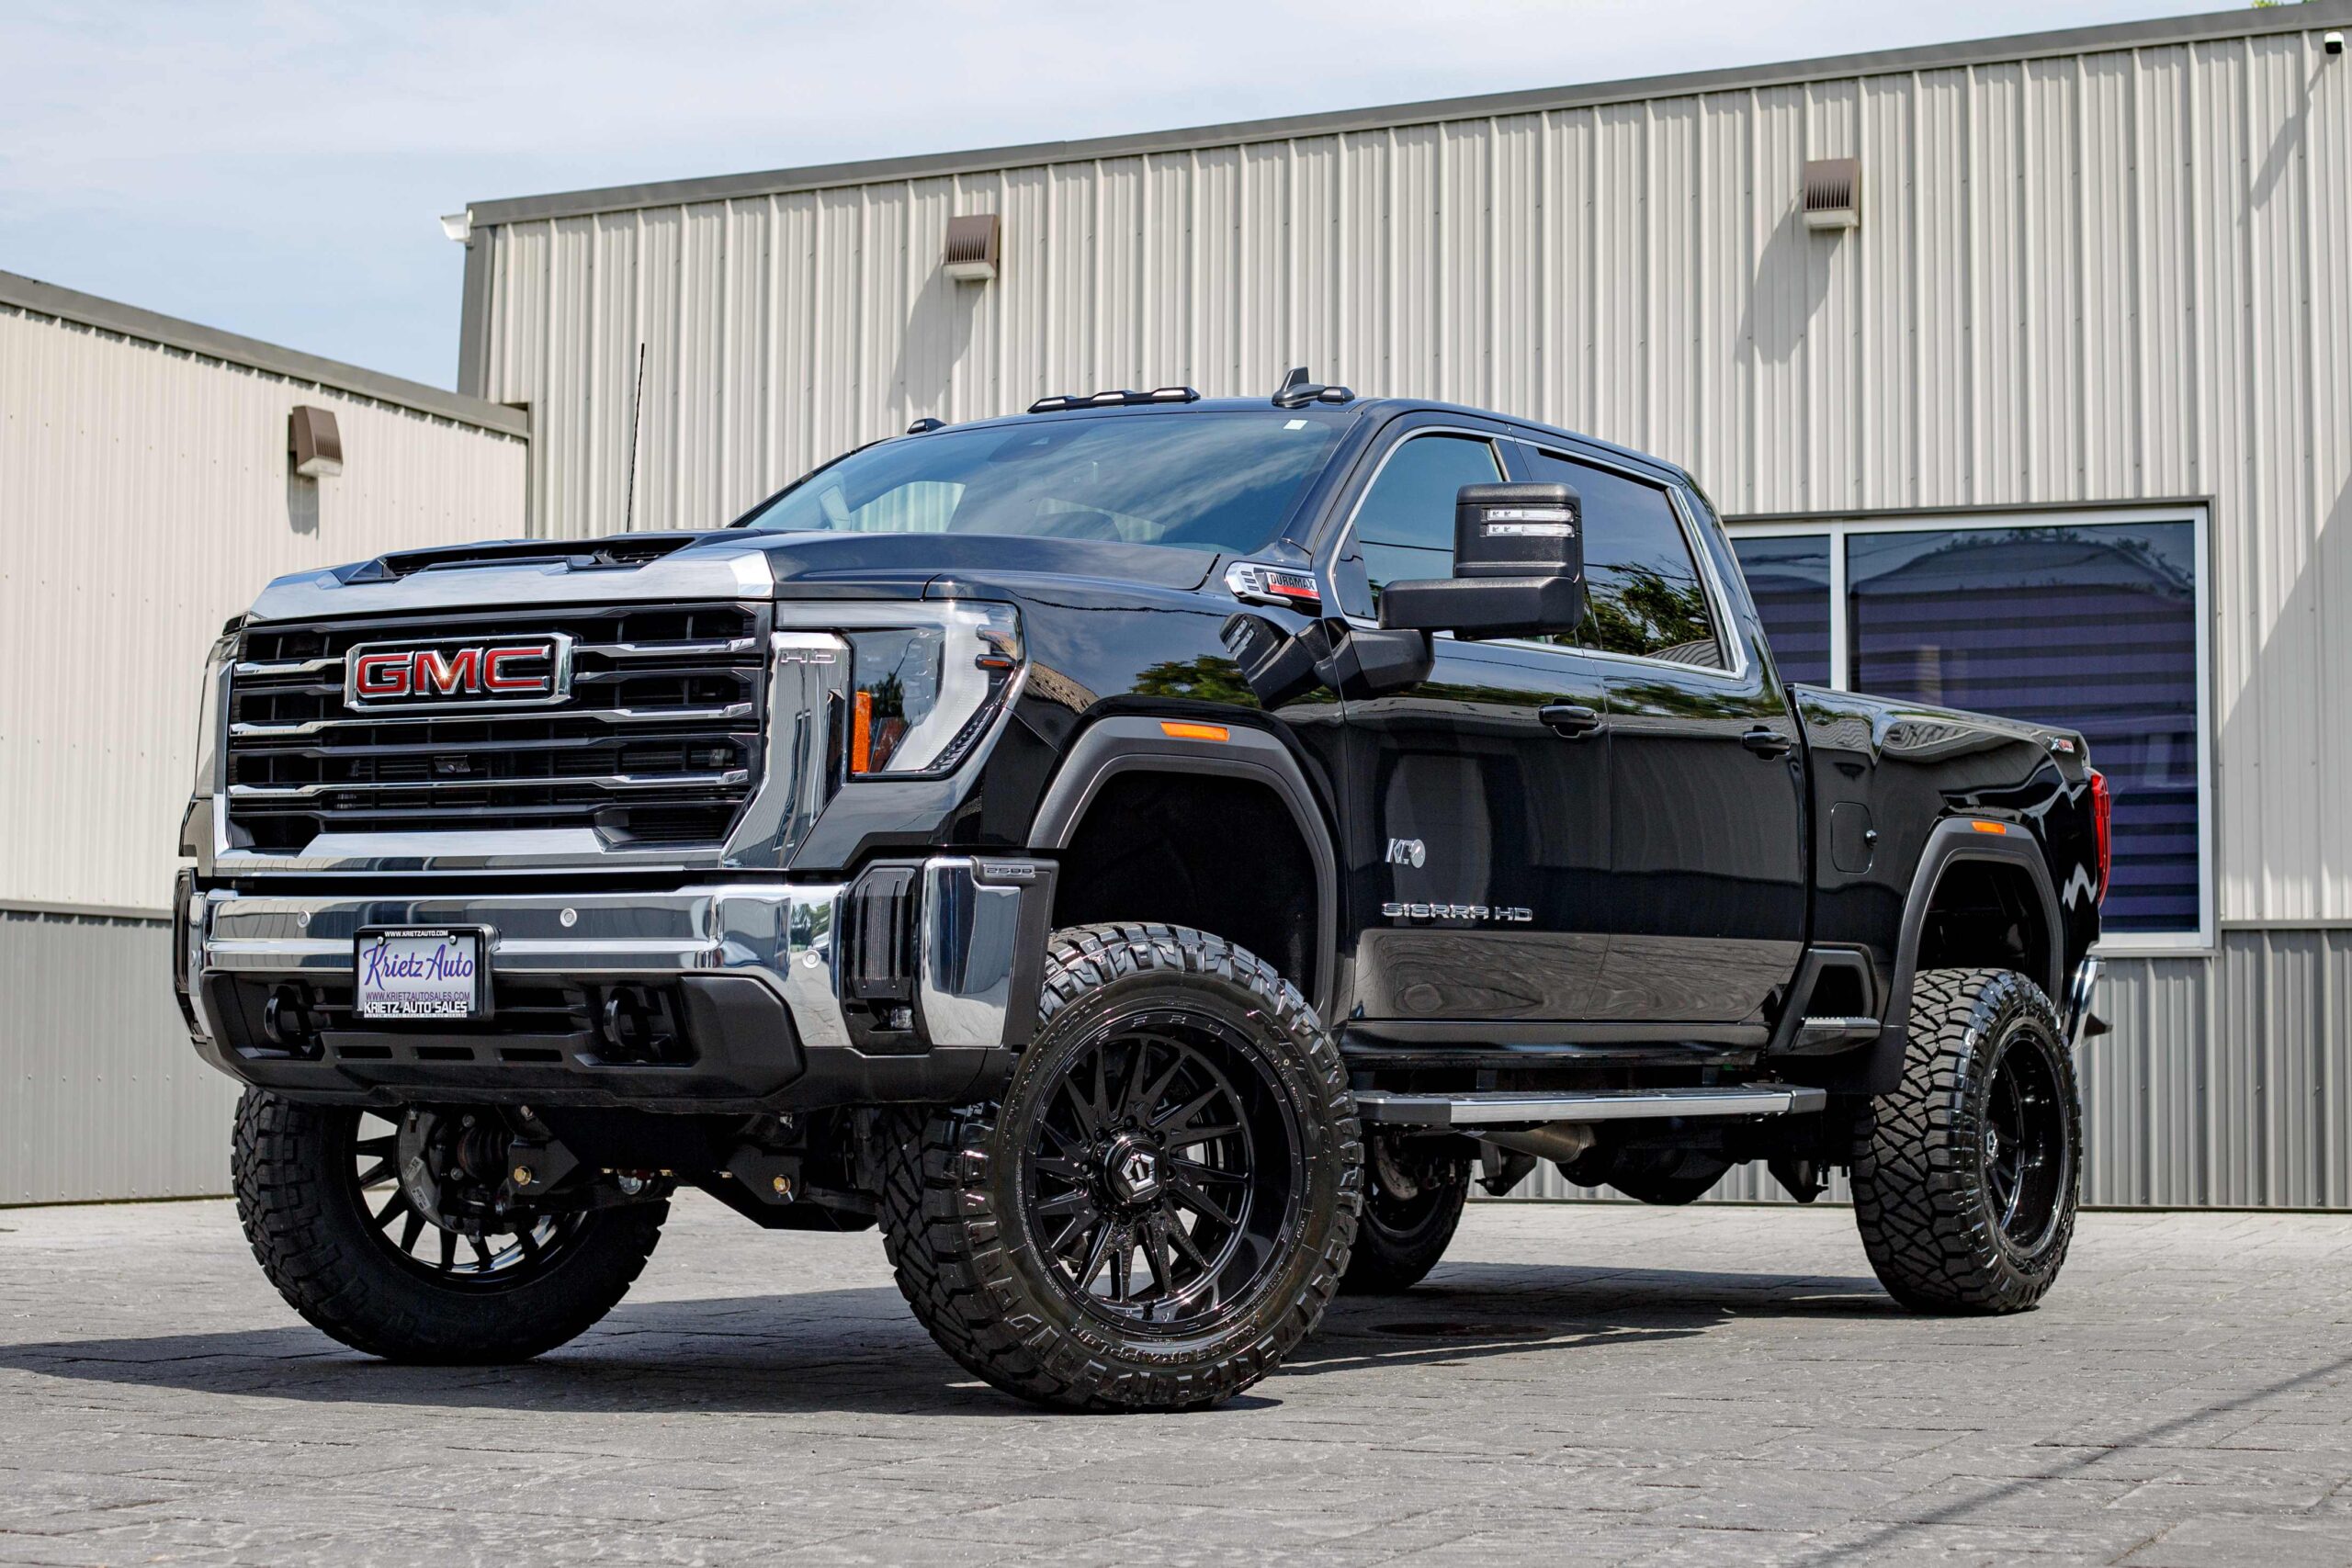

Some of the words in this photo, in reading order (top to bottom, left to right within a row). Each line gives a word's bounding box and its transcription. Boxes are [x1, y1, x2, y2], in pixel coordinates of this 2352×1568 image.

[1270, 574, 1316, 591] DURAMAX
[780, 651, 836, 663] HD
[356, 645, 551, 698] GMC
[1382, 903, 1489, 919] SIERRA
[1495, 906, 1533, 922] HD
[363, 942, 423, 991] Krietz
[425, 943, 474, 981] Auto
[366, 992, 470, 1001] WWW.KRIETZAUTOSALES.COM
[364, 1001, 400, 1013] KRIETZ
[402, 1001, 432, 1013] AUTO
[435, 1001, 468, 1013] SALES
